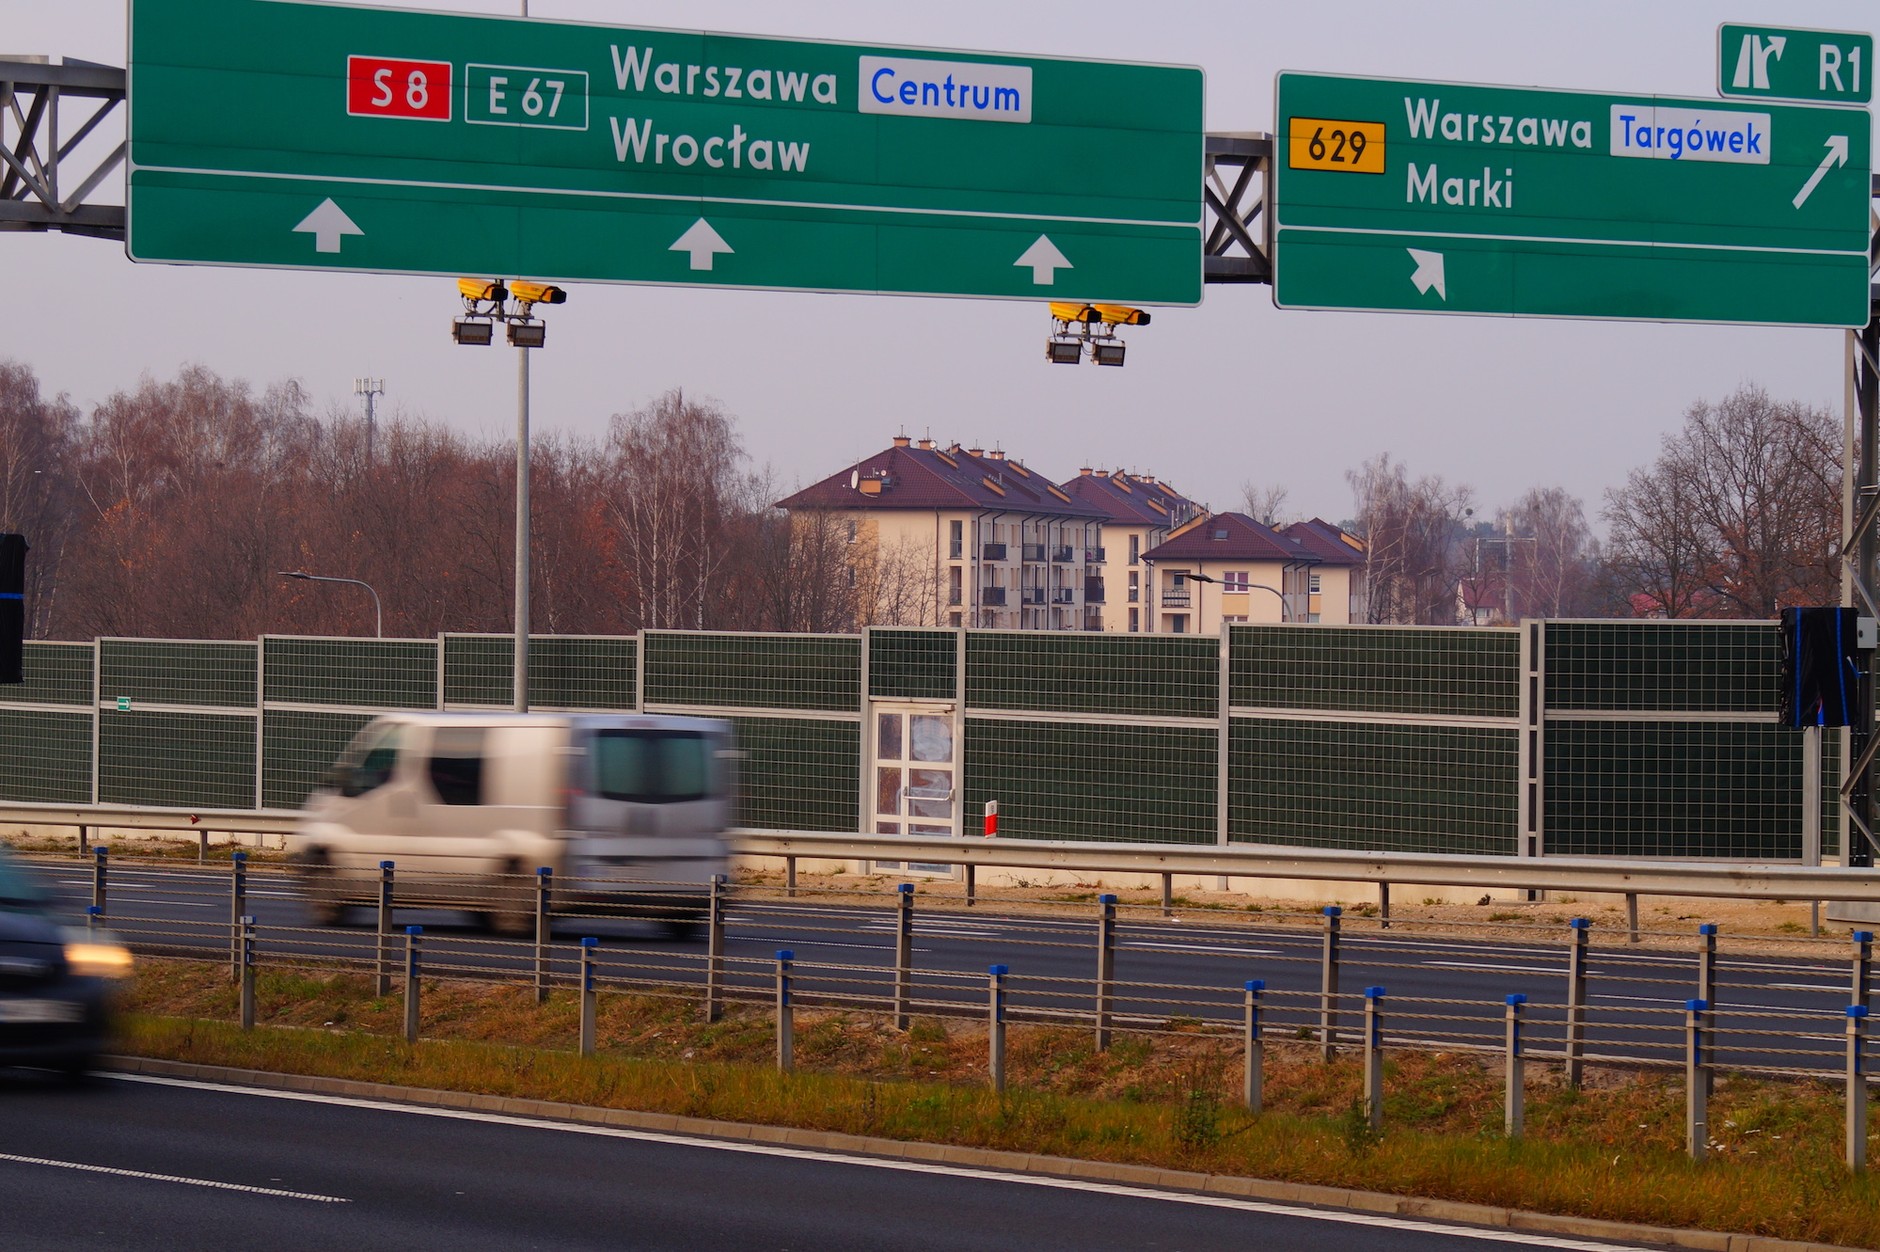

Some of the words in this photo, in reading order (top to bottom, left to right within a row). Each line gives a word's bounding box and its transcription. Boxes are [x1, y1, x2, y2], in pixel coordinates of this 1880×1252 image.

[372, 68, 393, 107] S
[407, 70, 428, 109] 8
[610, 45, 837, 104] Warszawa
[871, 67, 1020, 112] Centrum
[1819, 44, 1861, 93] R1
[490, 76, 508, 114] E
[522, 78, 565, 118] 67
[610, 116, 810, 172] Wrocław
[1404, 97, 1592, 148] Warszawa
[1619, 114, 1762, 160] Targówek
[1308, 127, 1367, 165] 629
[1406, 163, 1512, 208] Marki
